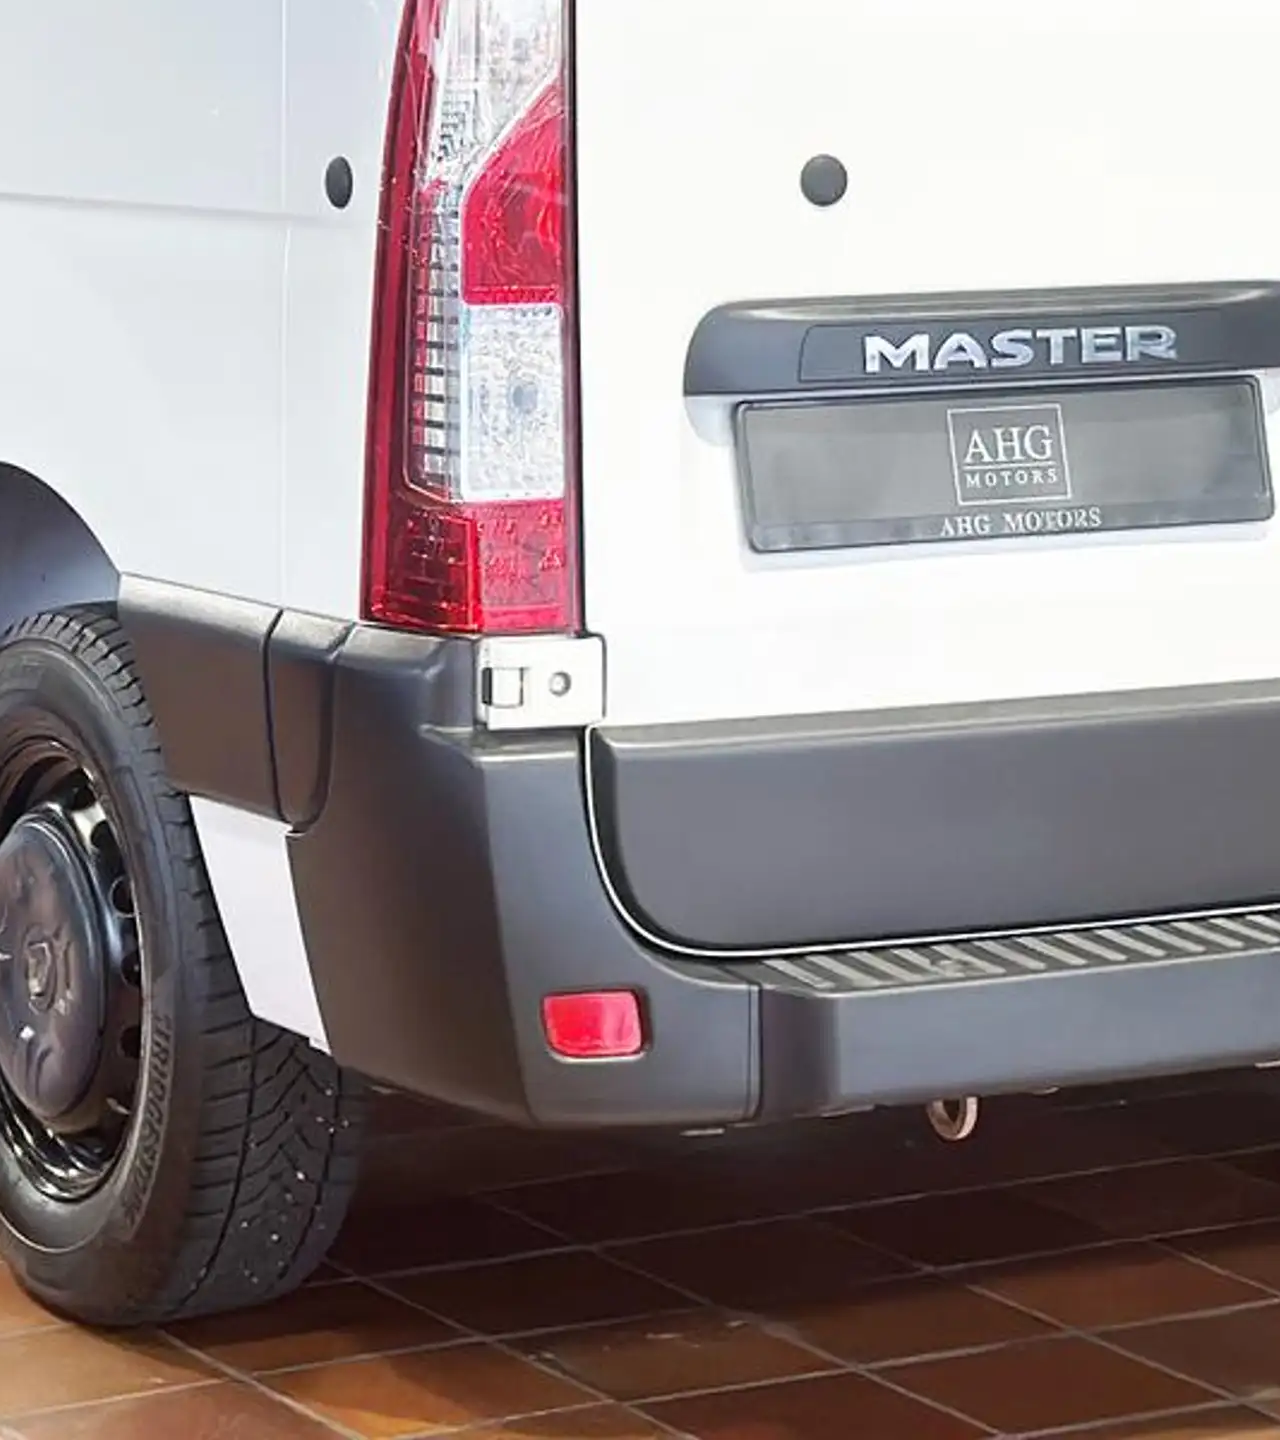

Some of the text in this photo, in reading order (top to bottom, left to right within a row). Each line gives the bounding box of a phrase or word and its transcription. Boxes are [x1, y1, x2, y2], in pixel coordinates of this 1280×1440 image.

[864, 324, 1178, 373] MASTER
[964, 424, 1053, 462] AHG
[964, 468, 1058, 489] MOTORS
[940, 506, 1102, 537] AHG MOTORS
